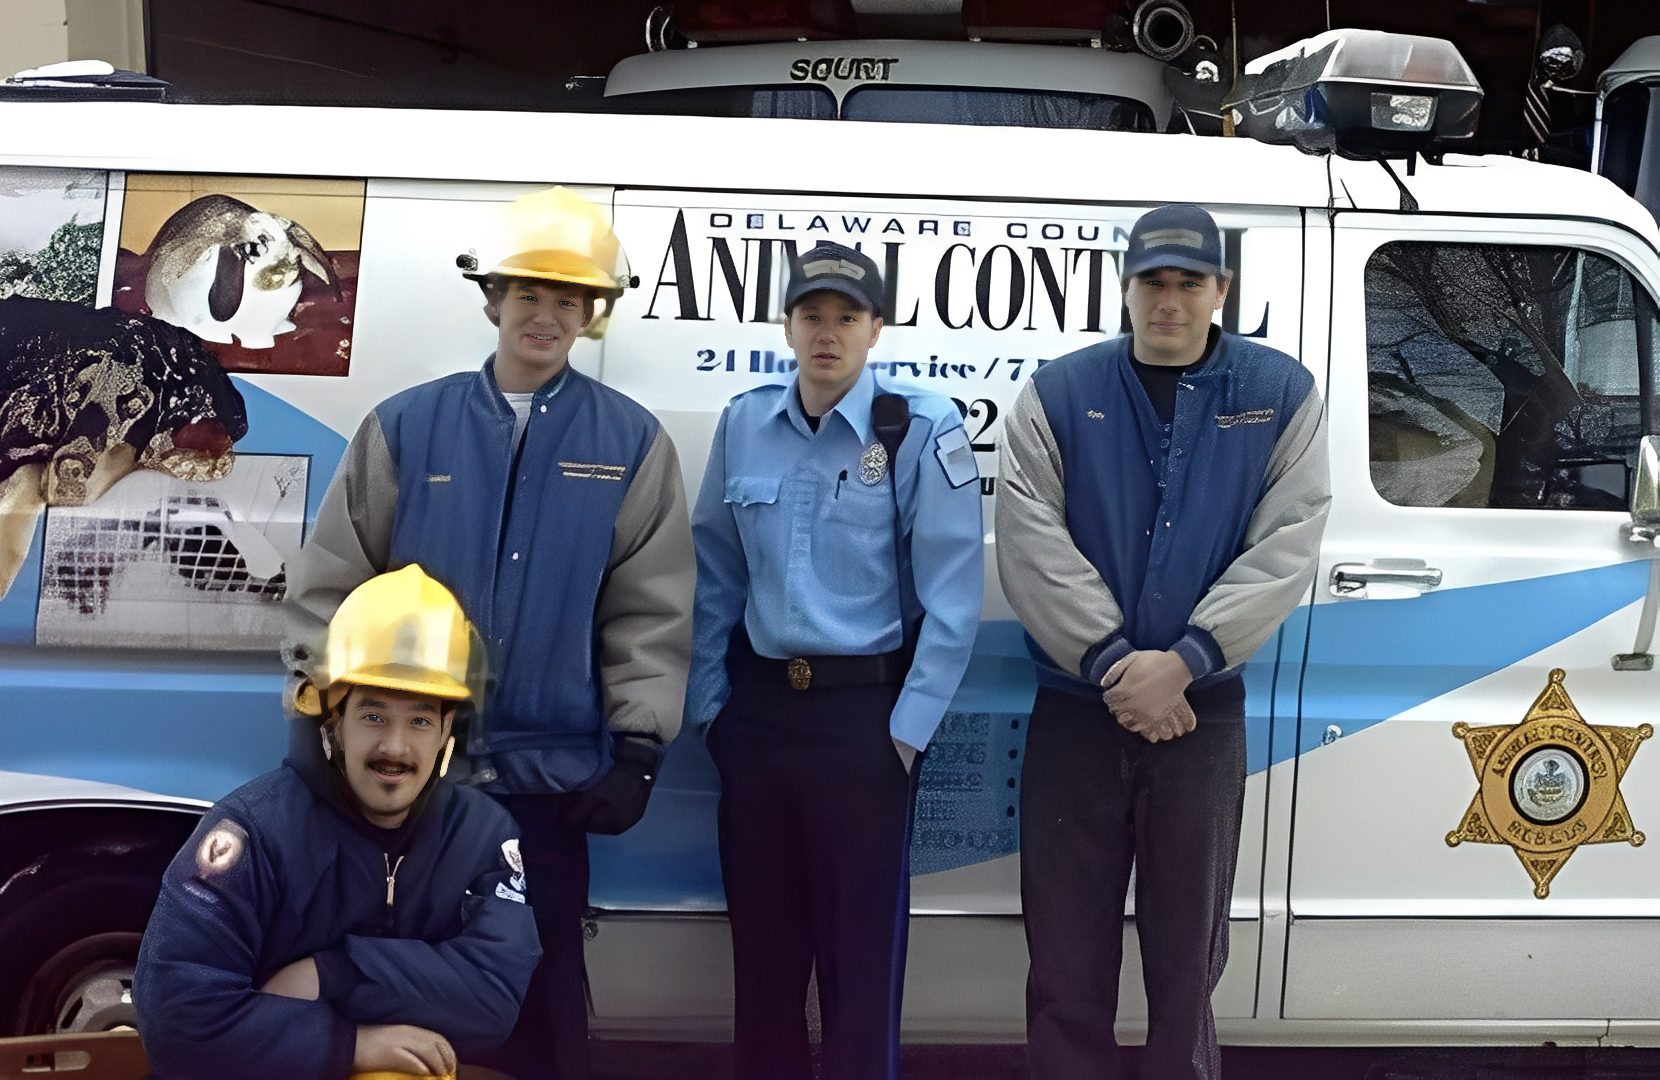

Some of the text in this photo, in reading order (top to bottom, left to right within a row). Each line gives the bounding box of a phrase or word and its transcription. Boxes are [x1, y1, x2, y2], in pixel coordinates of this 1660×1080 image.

[710, 212, 971, 237] DELAWARE
[641, 208, 1269, 338] ANIL CONTL
